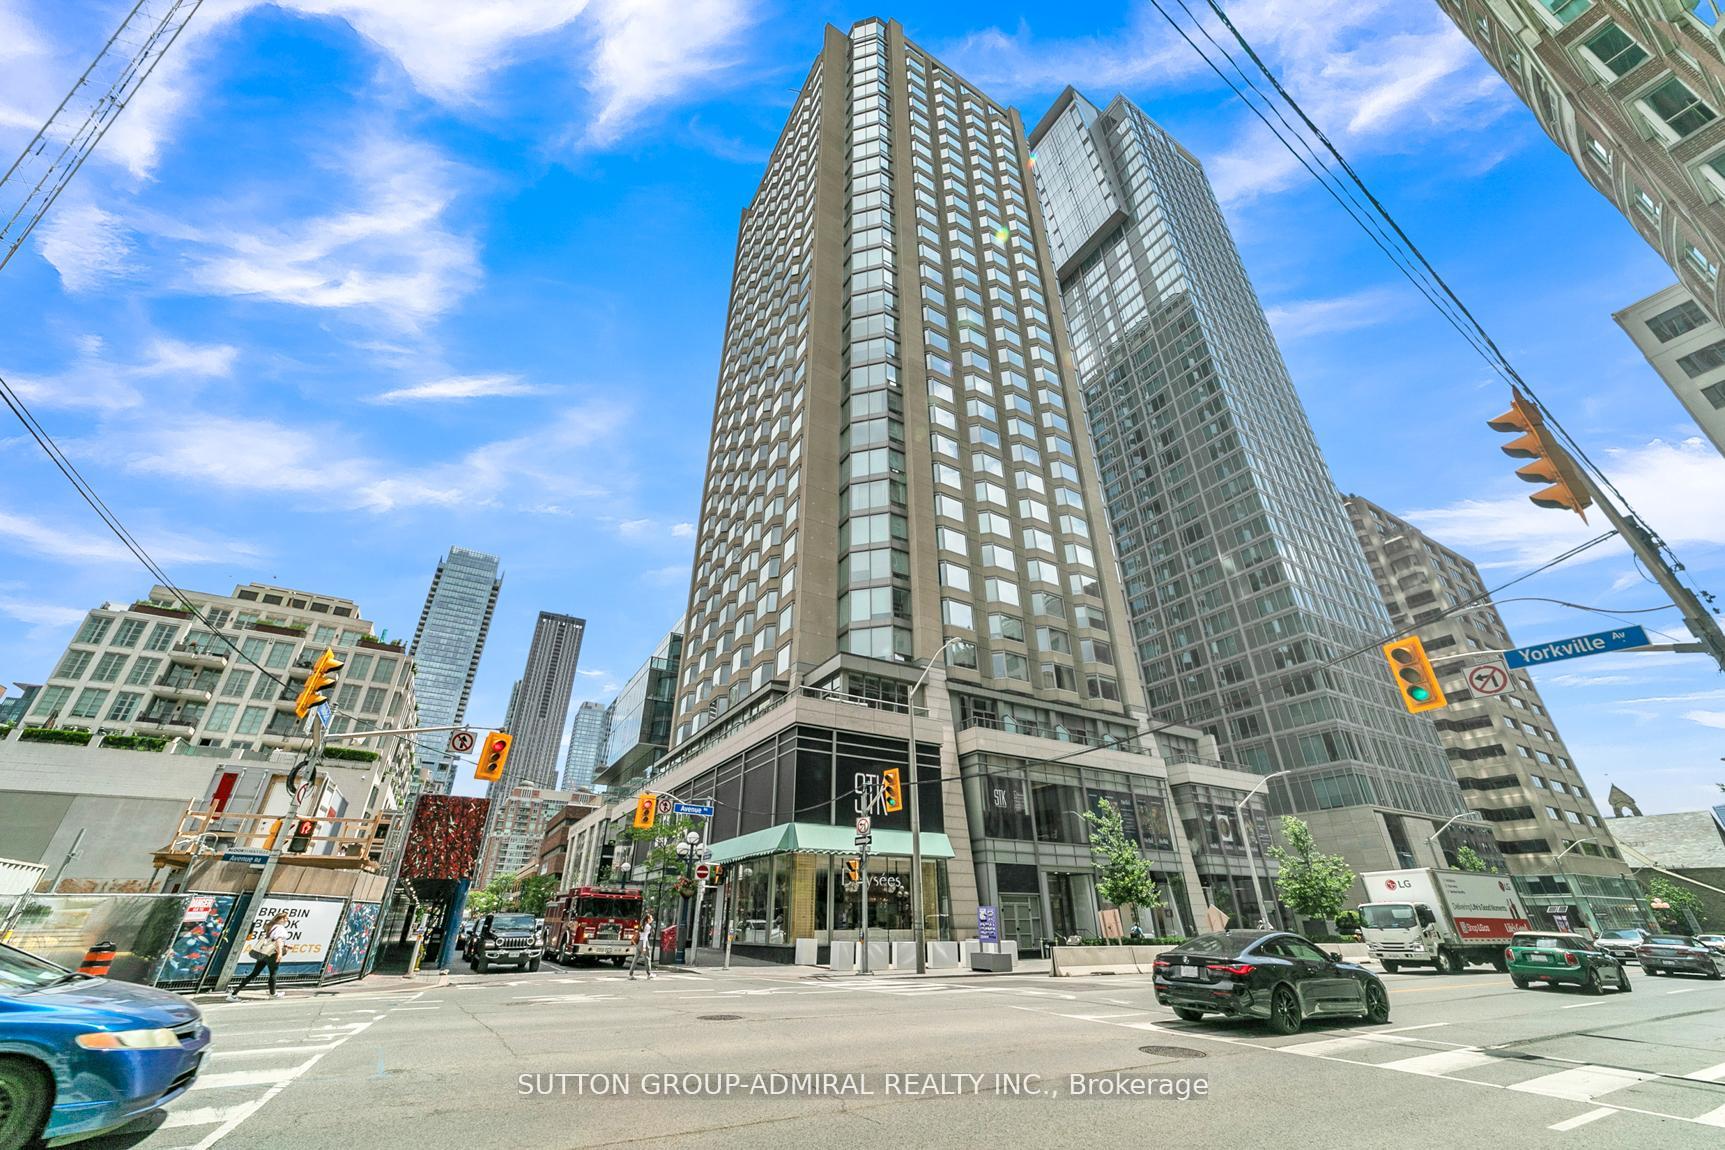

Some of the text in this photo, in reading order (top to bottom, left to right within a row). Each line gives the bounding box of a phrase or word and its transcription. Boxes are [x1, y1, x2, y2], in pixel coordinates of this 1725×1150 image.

[1518, 631, 1626, 662] Yorkville Av
[680, 805, 702, 813] Avenue
[1397, 879, 1412, 889] LG
[258, 907, 310, 918] BRISBIN
